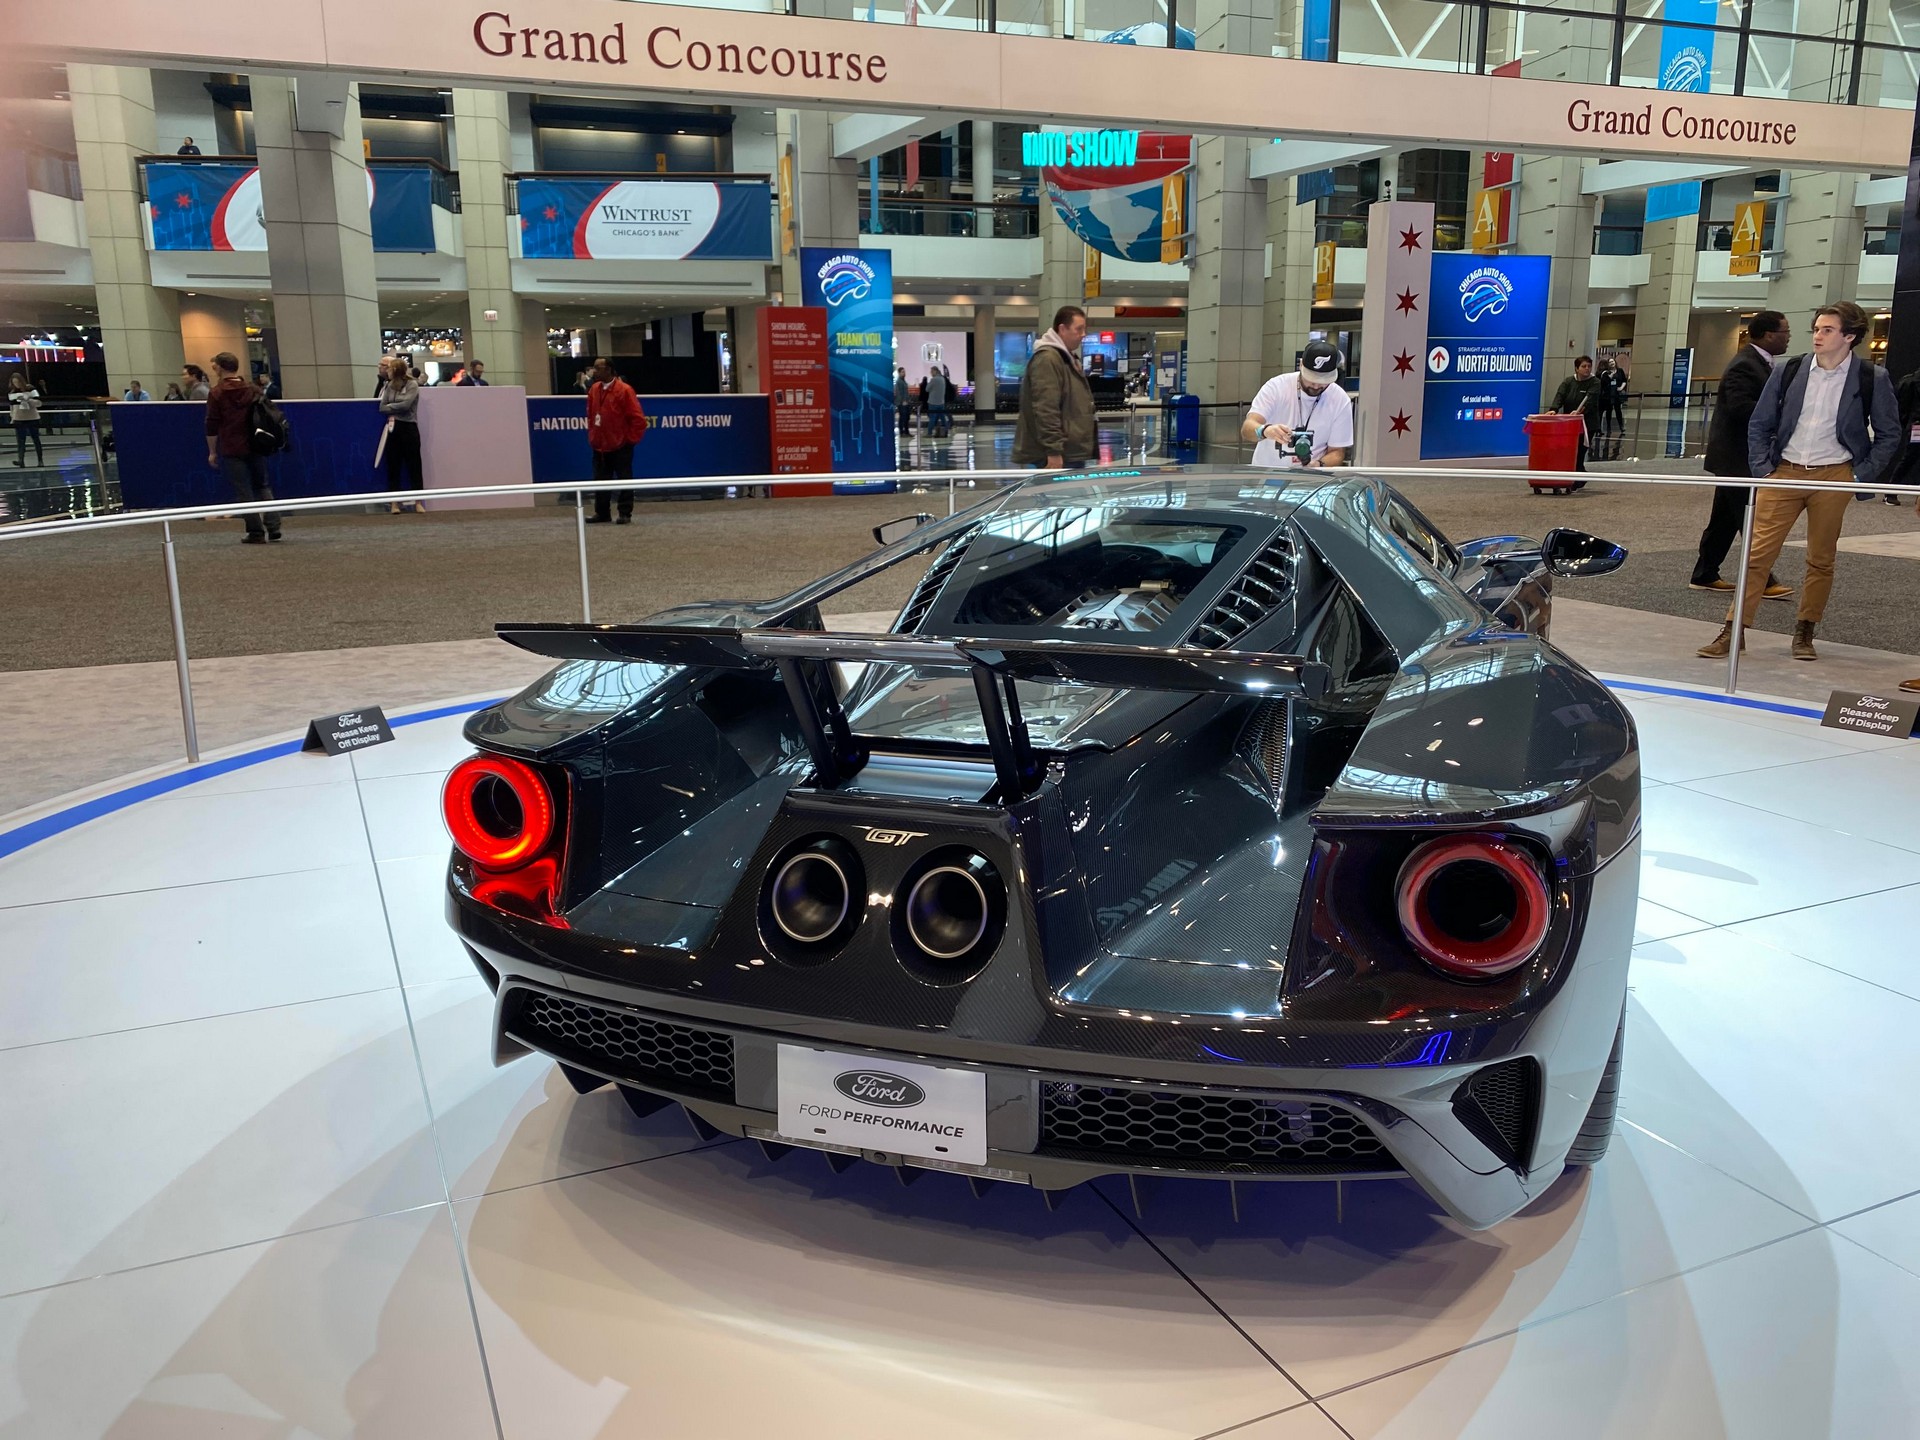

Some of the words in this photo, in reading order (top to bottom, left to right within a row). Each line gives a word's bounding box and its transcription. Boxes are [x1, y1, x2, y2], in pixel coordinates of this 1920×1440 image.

[473, 11, 628, 65] Grand
[647, 26, 887, 83] Concourse
[1662, 51, 1682, 81] CHICAGO
[1682, 46, 1696, 57] AUTO
[1694, 48, 1708, 68] SHOW
[1567, 99, 1652, 136] Grand
[1662, 106, 1797, 145] Concourse
[1071, 130, 1139, 167] SHOW
[601, 204, 692, 222] WINTRUST
[612, 228, 656, 237] CHICAGO'S
[817, 256, 842, 279] CHICAGO
[841, 254, 859, 265] AUTO
[858, 257, 876, 279] SHOW
[1730, 259, 1757, 268] SOUTH
[1458, 269, 1483, 293] CHICAGO
[1482, 267, 1499, 278] AUTO
[1497, 272, 1514, 295] SHOW
[836, 332, 864, 346] THANK
[865, 332, 882, 346] YOU
[1457, 354, 1489, 373] NORTH
[1489, 354, 1532, 372] BUILDING
[1461, 395, 1470, 403] Get
[1469, 395, 1482, 403] social
[1481, 395, 1491, 403] with
[541, 416, 588, 431] NATION
[661, 415, 693, 429] AUTO
[696, 414, 732, 428] SHOW
[1856, 695, 1890, 710] Ford
[338, 713, 363, 728] Ford
[1839, 707, 1873, 719] Please
[1873, 711, 1900, 723] Keep
[331, 727, 359, 741] Please
[359, 724, 379, 735] Keep
[1838, 716, 1856, 726] Off
[1855, 718, 1893, 732] Display
[338, 738, 352, 749] Off
[352, 733, 380, 747] Display
[864, 828, 930, 847] GT
[851, 1073, 906, 1102] Ford
[799, 1103, 842, 1120] FORD
[843, 1110, 965, 1138] PERFORMANCE
